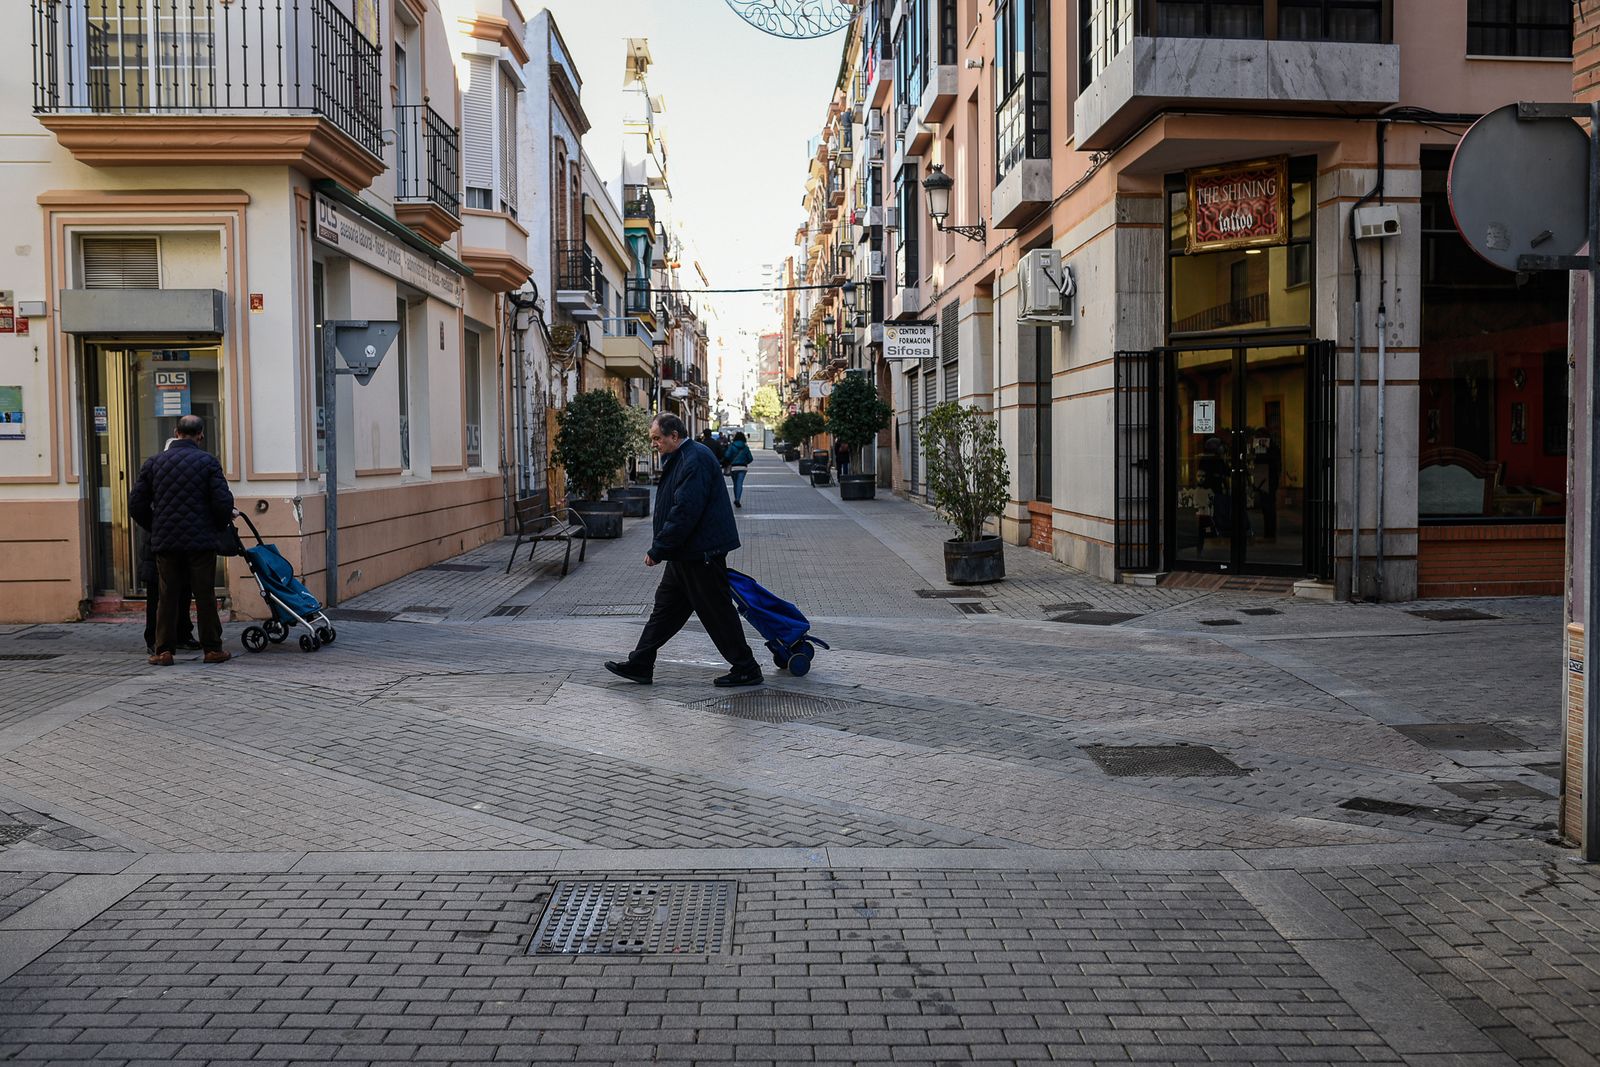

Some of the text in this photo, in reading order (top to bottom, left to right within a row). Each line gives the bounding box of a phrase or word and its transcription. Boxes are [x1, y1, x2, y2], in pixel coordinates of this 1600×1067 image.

[1197, 178, 1276, 205] THE SHINING
[320, 199, 338, 229] DLS
[1219, 208, 1253, 233] tattoo
[887, 346, 930, 355] Sifosa
[157, 373, 185, 385] DLS
